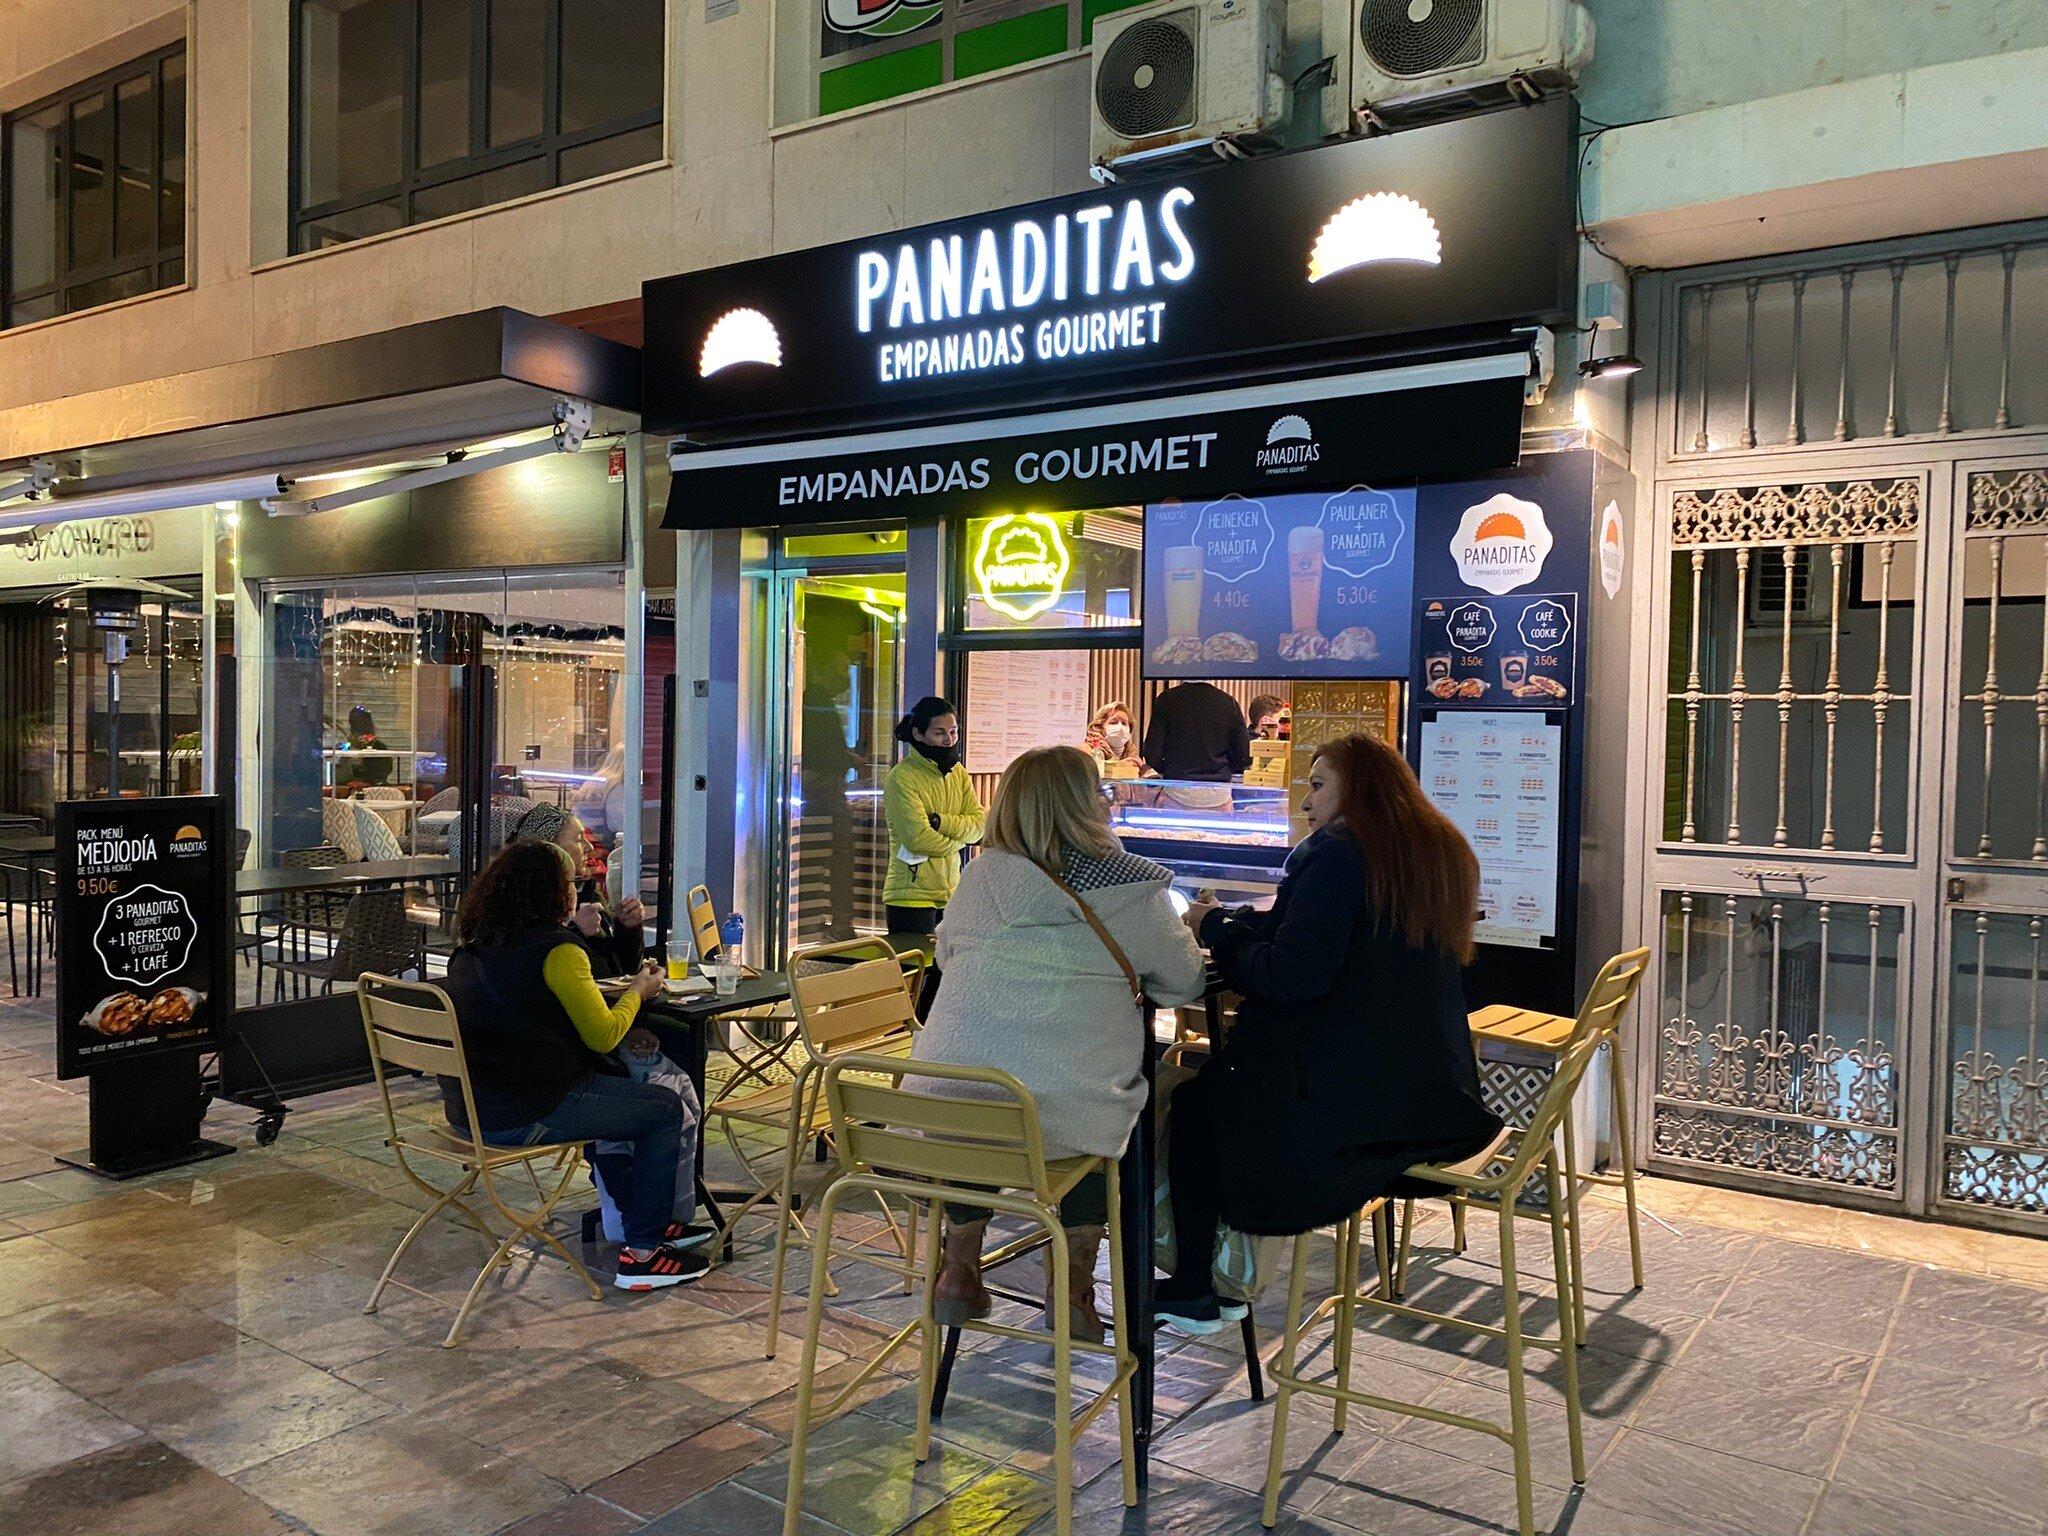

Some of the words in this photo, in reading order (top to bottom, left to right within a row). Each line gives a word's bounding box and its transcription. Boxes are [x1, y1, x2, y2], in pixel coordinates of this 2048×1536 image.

[857, 186, 1196, 334] PANADITAS
[879, 324, 1026, 382] EMPANADAS
[1037, 302, 1167, 361] GOURMET
[1256, 443, 1320, 467] PANADITAS
[779, 458, 990, 505] EMPANADAS
[1014, 432, 1218, 484] GOURMET
[1207, 511, 1259, 529] HEINEKEN
[1330, 503, 1388, 522] PAULANER
[1207, 539, 1258, 556] PANADITA
[1331, 532, 1386, 550] PANADITA
[1464, 545, 1536, 565] PANADITAS
[1337, 586, 1378, 604] 5.30€
[1463, 609, 1481, 621] CAFÉ
[1535, 608, 1554, 621] CAFÉ
[1455, 627, 1487, 637] PANADITA
[1530, 628, 1558, 639] COOKIE
[77, 829, 98, 841] PACK
[100, 824, 124, 840] MENÚ
[77, 833, 158, 866] MEDIODÍA
[169, 841, 208, 854] PANADITAS
[111, 863, 133, 873] HORAS
[77, 877, 118, 897] 9.50€
[115, 904, 124, 920] 3
[126, 899, 179, 919] PANADITAS
[133, 916, 162, 927] GOURMET
[127, 926, 181, 946] REFRESCO
[137, 943, 165, 954] CERVEZA
[142, 951, 168, 972] CAFÉ
